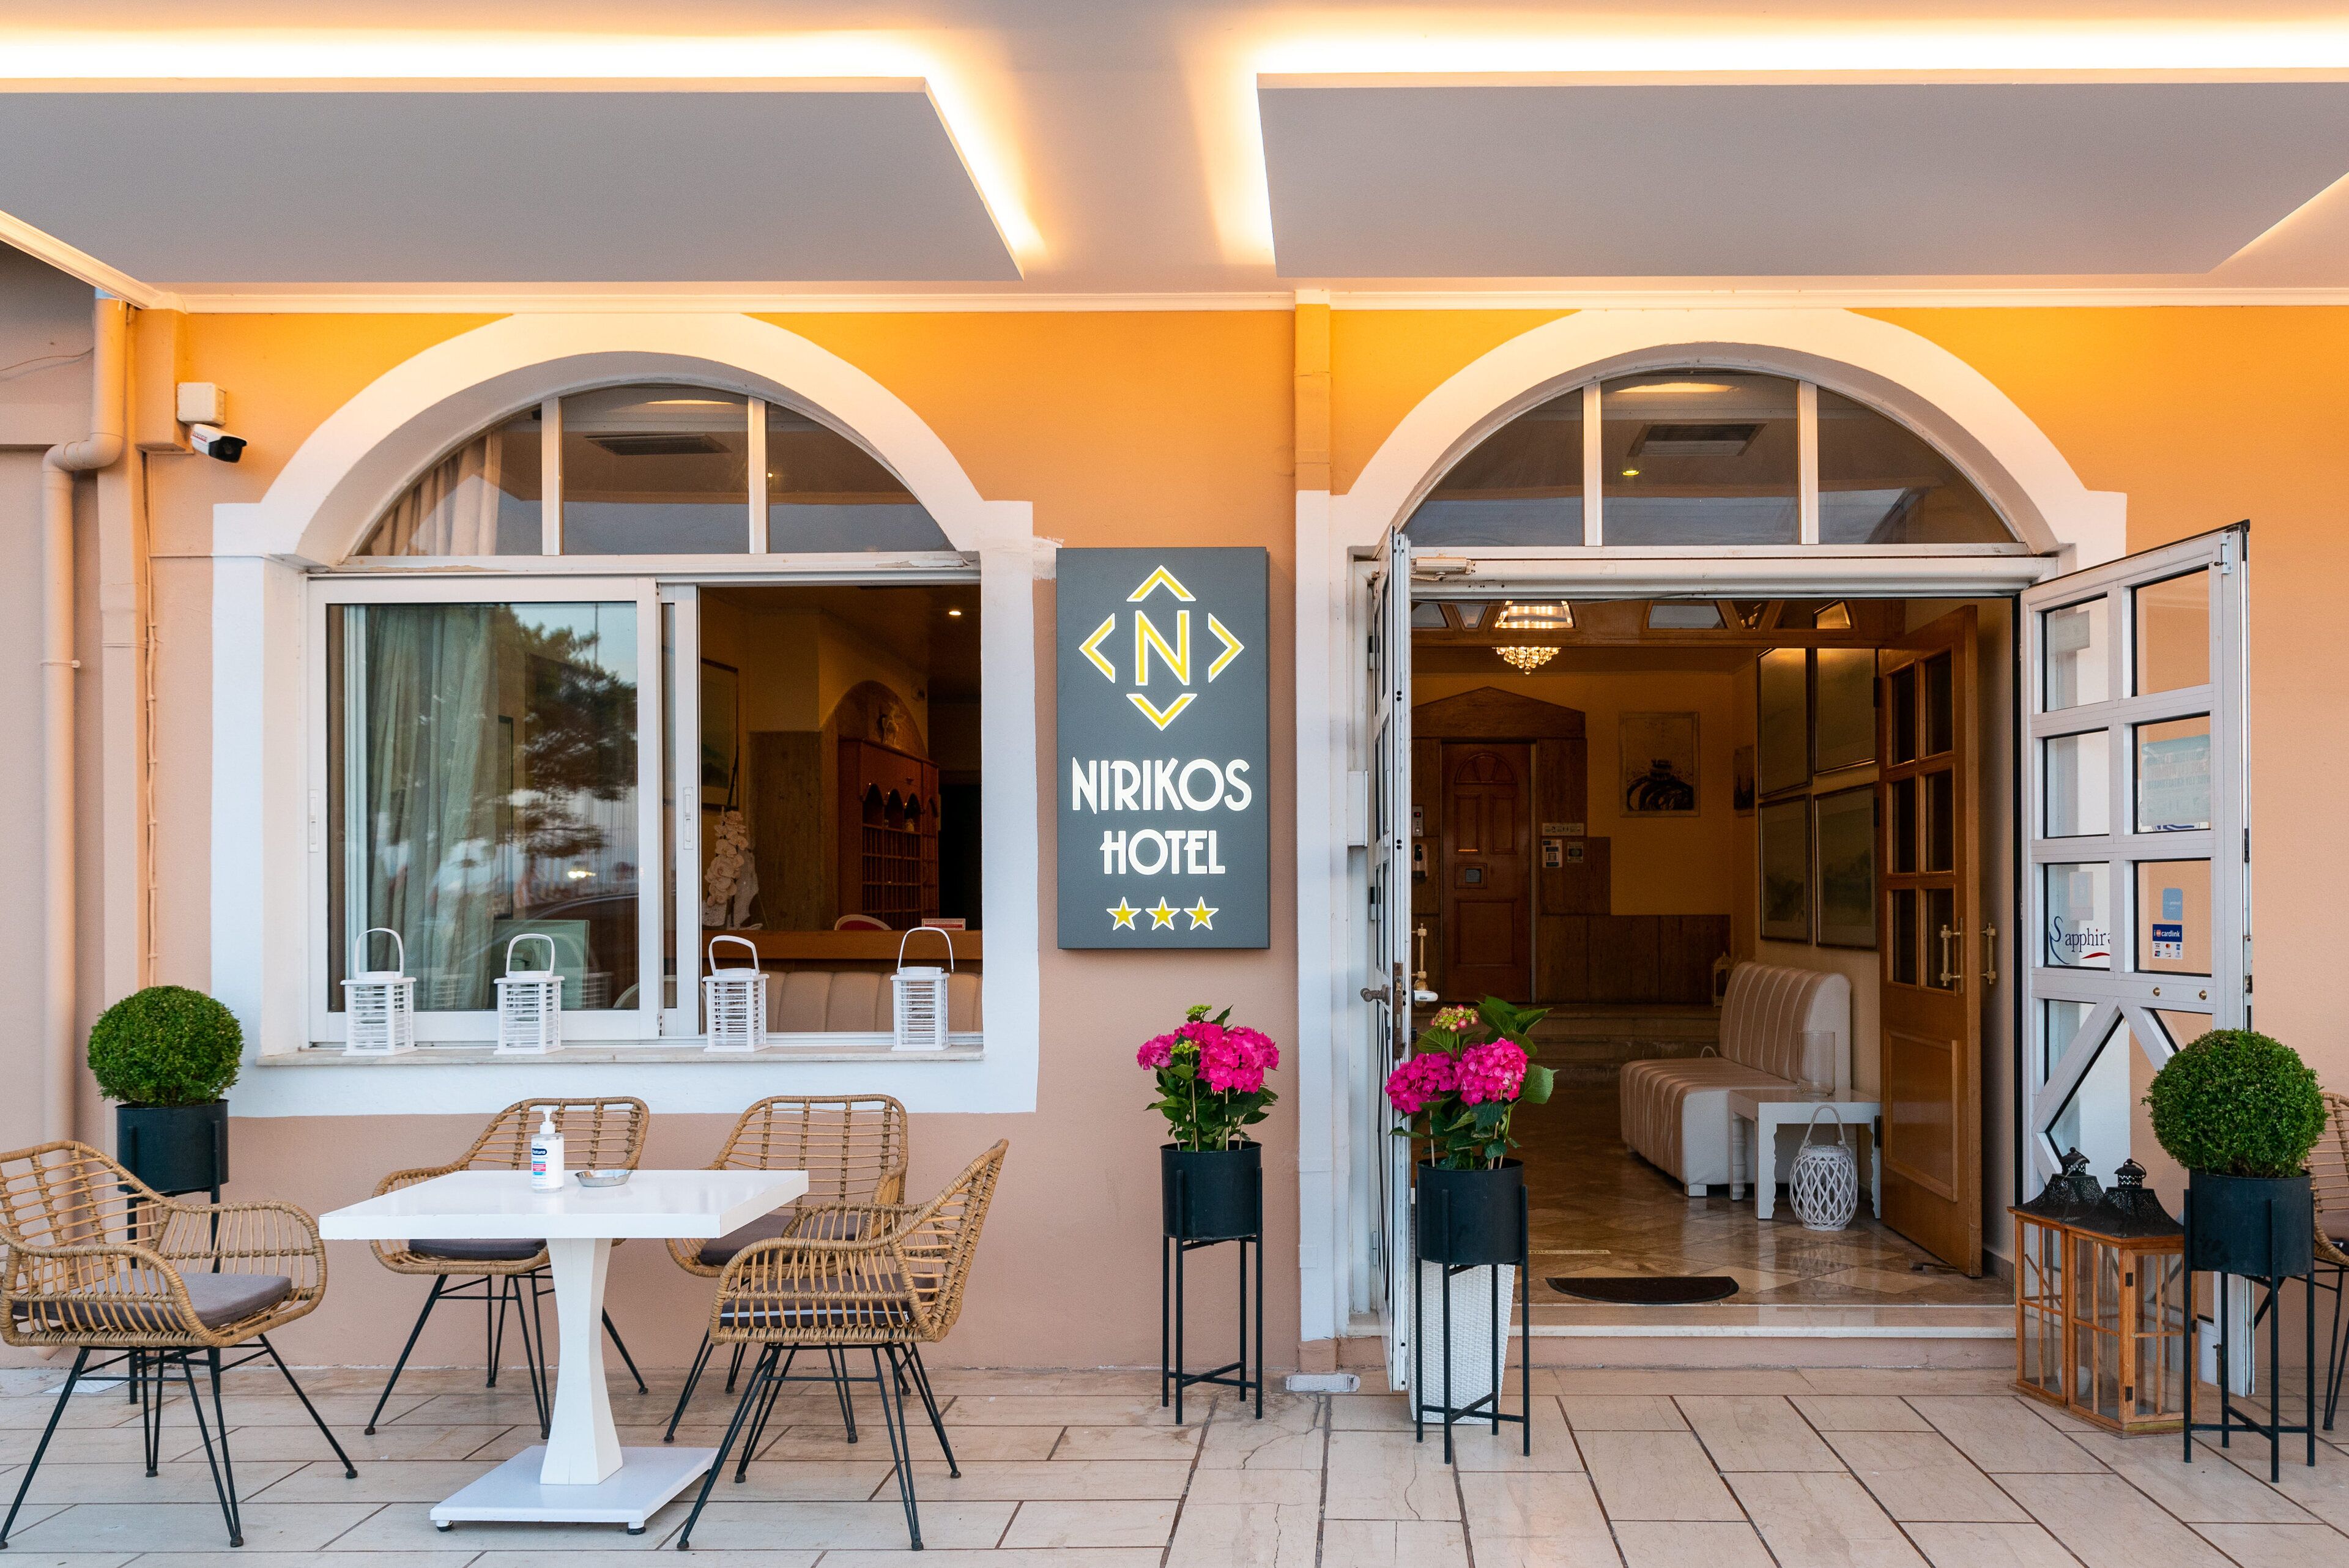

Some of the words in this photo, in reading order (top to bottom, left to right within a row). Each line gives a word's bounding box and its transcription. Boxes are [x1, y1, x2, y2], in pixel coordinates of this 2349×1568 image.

[1135, 609, 1189, 686] N
[1072, 757, 1252, 814] NIRIKOS
[1099, 828, 1225, 875] HOTEL
